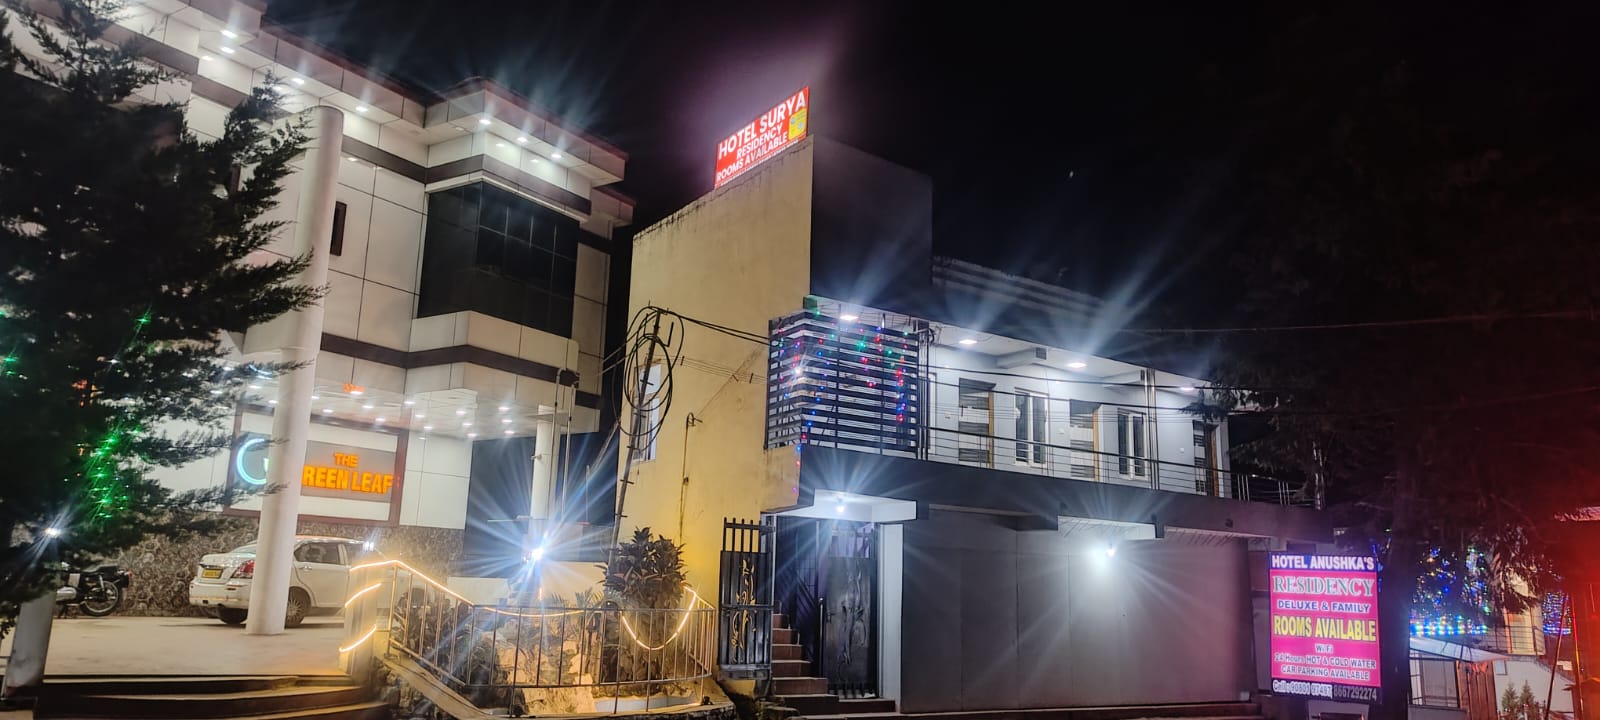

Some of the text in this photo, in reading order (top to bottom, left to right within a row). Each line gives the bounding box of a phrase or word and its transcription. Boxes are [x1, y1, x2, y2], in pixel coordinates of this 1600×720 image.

[718, 90, 806, 160] HOTEL SURYA
[737, 122, 782, 159] RESIDENCY
[717, 132, 788, 182] ROOMS AVAILABLE
[334, 452, 359, 467] THE
[302, 464, 394, 494] REEN LEAF
[1272, 555, 1374, 570] HOTEL ANUSHKA'S
[1273, 576, 1375, 597] RESIDENCY
[1278, 599, 1371, 614] DELUXE & FAMILY
[1274, 616, 1376, 641] ROOMS AVAILABLE
[1285, 653, 1304, 663] Hours
[1306, 655, 1321, 664] HOT
[1322, 656, 1328, 665] &
[1330, 657, 1349, 667] COLD
[1350, 658, 1376, 669] WATER
[1297, 666, 1329, 676] PARKING
[1330, 669, 1370, 680] AVAILABLE
